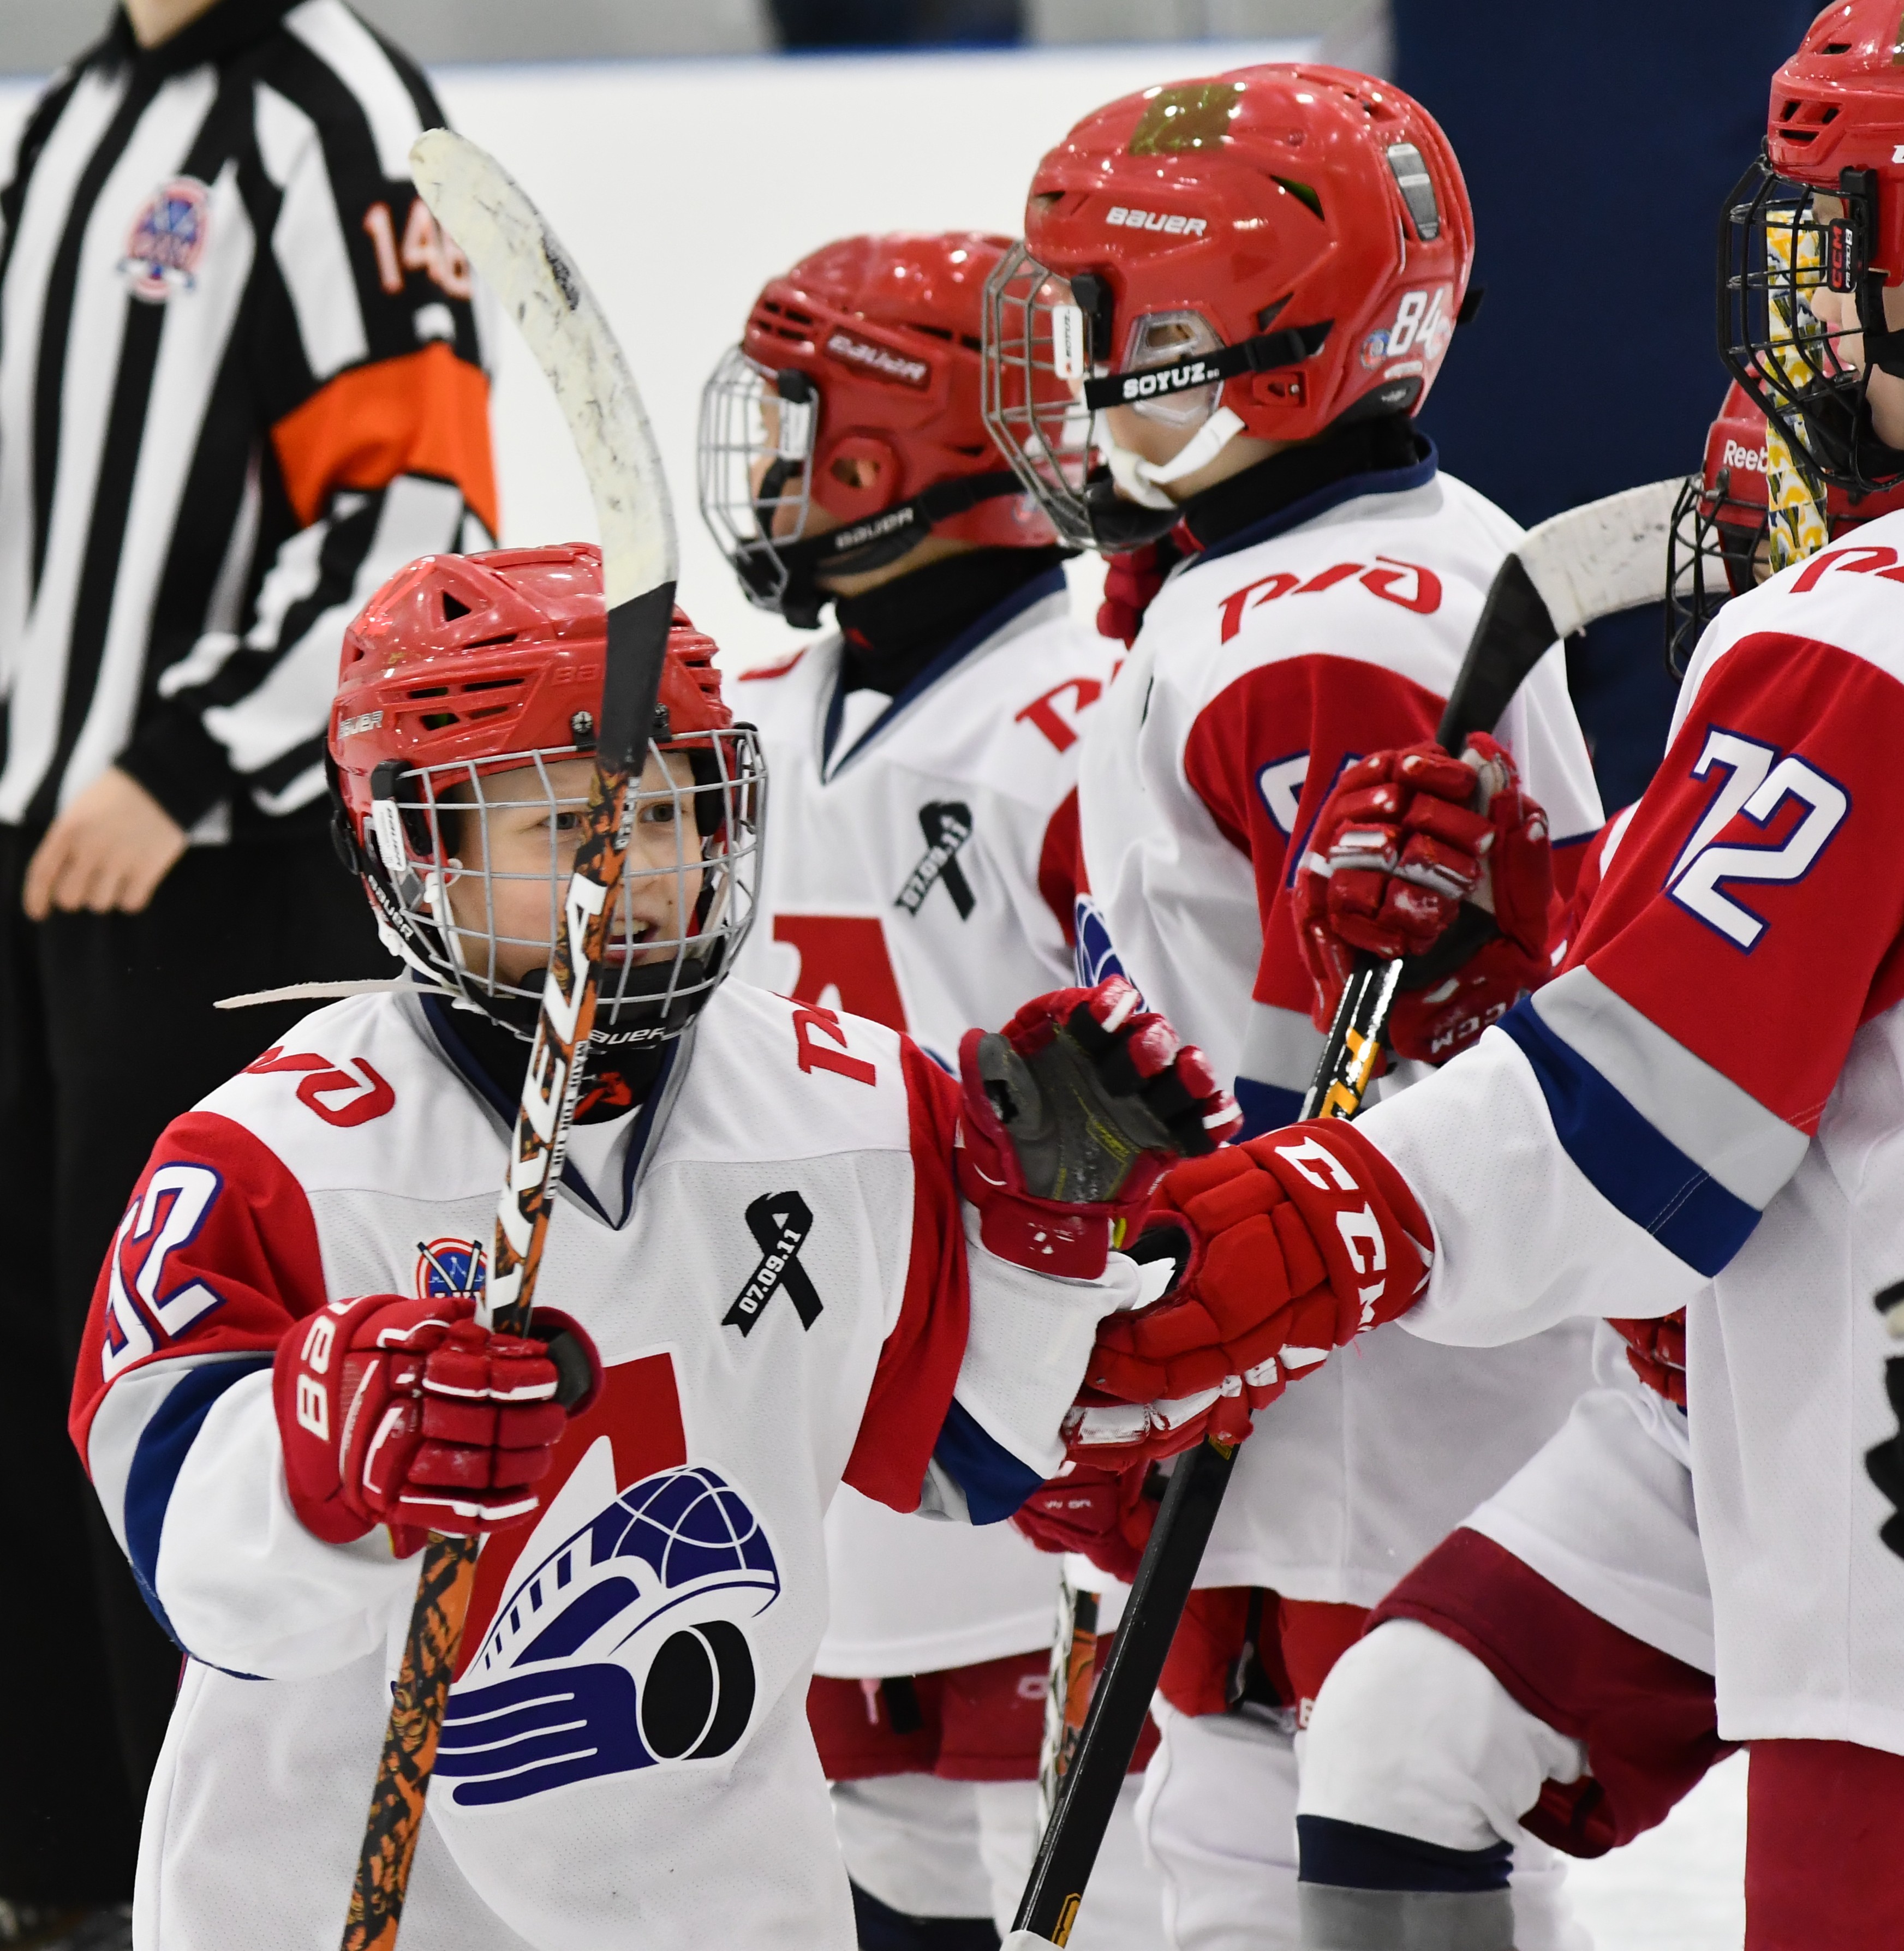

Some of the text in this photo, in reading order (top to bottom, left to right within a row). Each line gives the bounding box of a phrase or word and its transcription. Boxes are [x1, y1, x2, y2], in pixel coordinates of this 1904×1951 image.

[1106, 206, 1207, 237] BAUER
[1833, 225, 1842, 288] CCM
[1123, 362, 1205, 399] SOYUZ
[1723, 439, 1768, 472] Reeb
[1661, 723, 1852, 955] 72
[738, 1228, 802, 1315] 07.09.11
